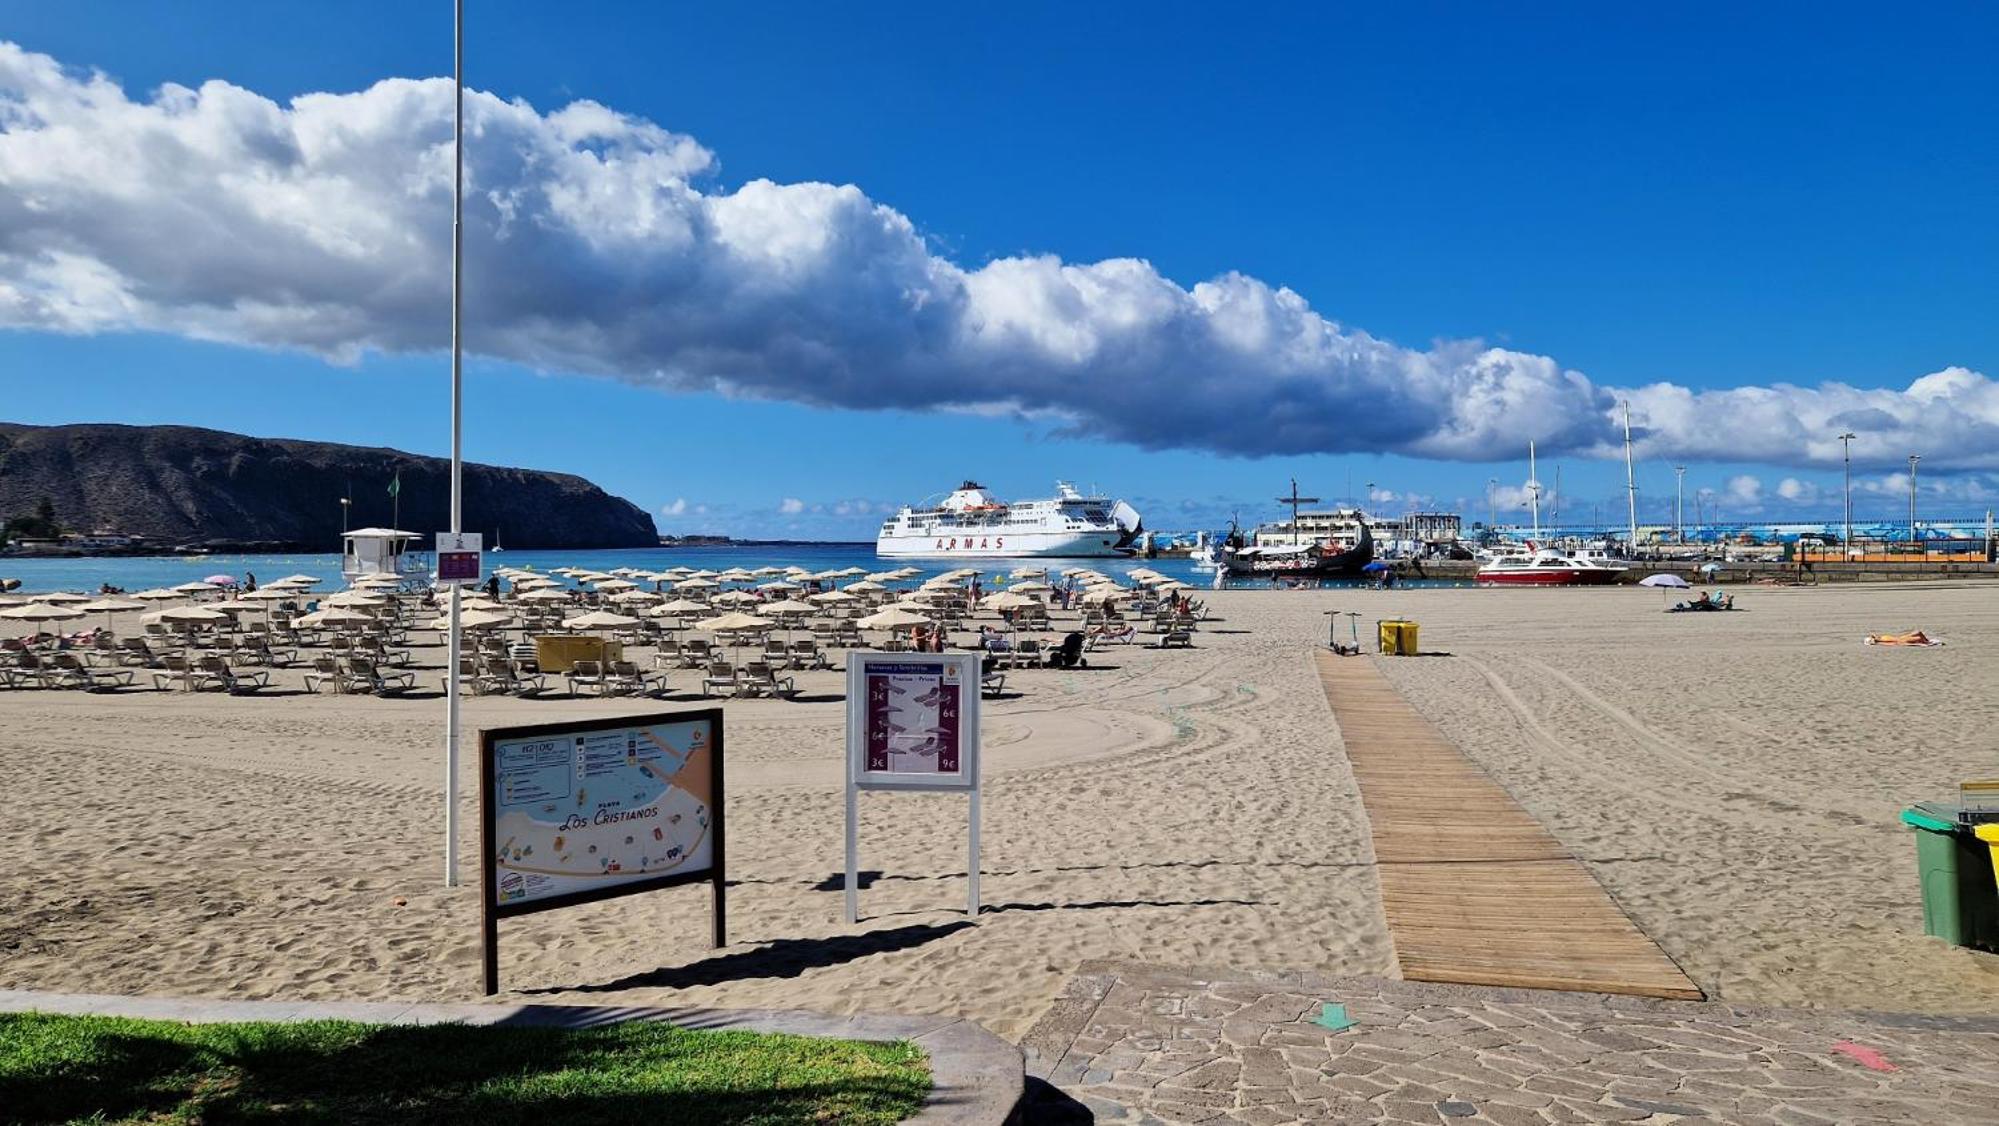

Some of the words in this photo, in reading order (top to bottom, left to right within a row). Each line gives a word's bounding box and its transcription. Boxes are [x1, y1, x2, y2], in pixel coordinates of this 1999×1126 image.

[936, 537, 1004, 550] ARMAS
[872, 691, 884, 701] 3€
[943, 709, 955, 718] 6€
[872, 759, 884, 767] 3€
[943, 759, 955, 768] 9€
